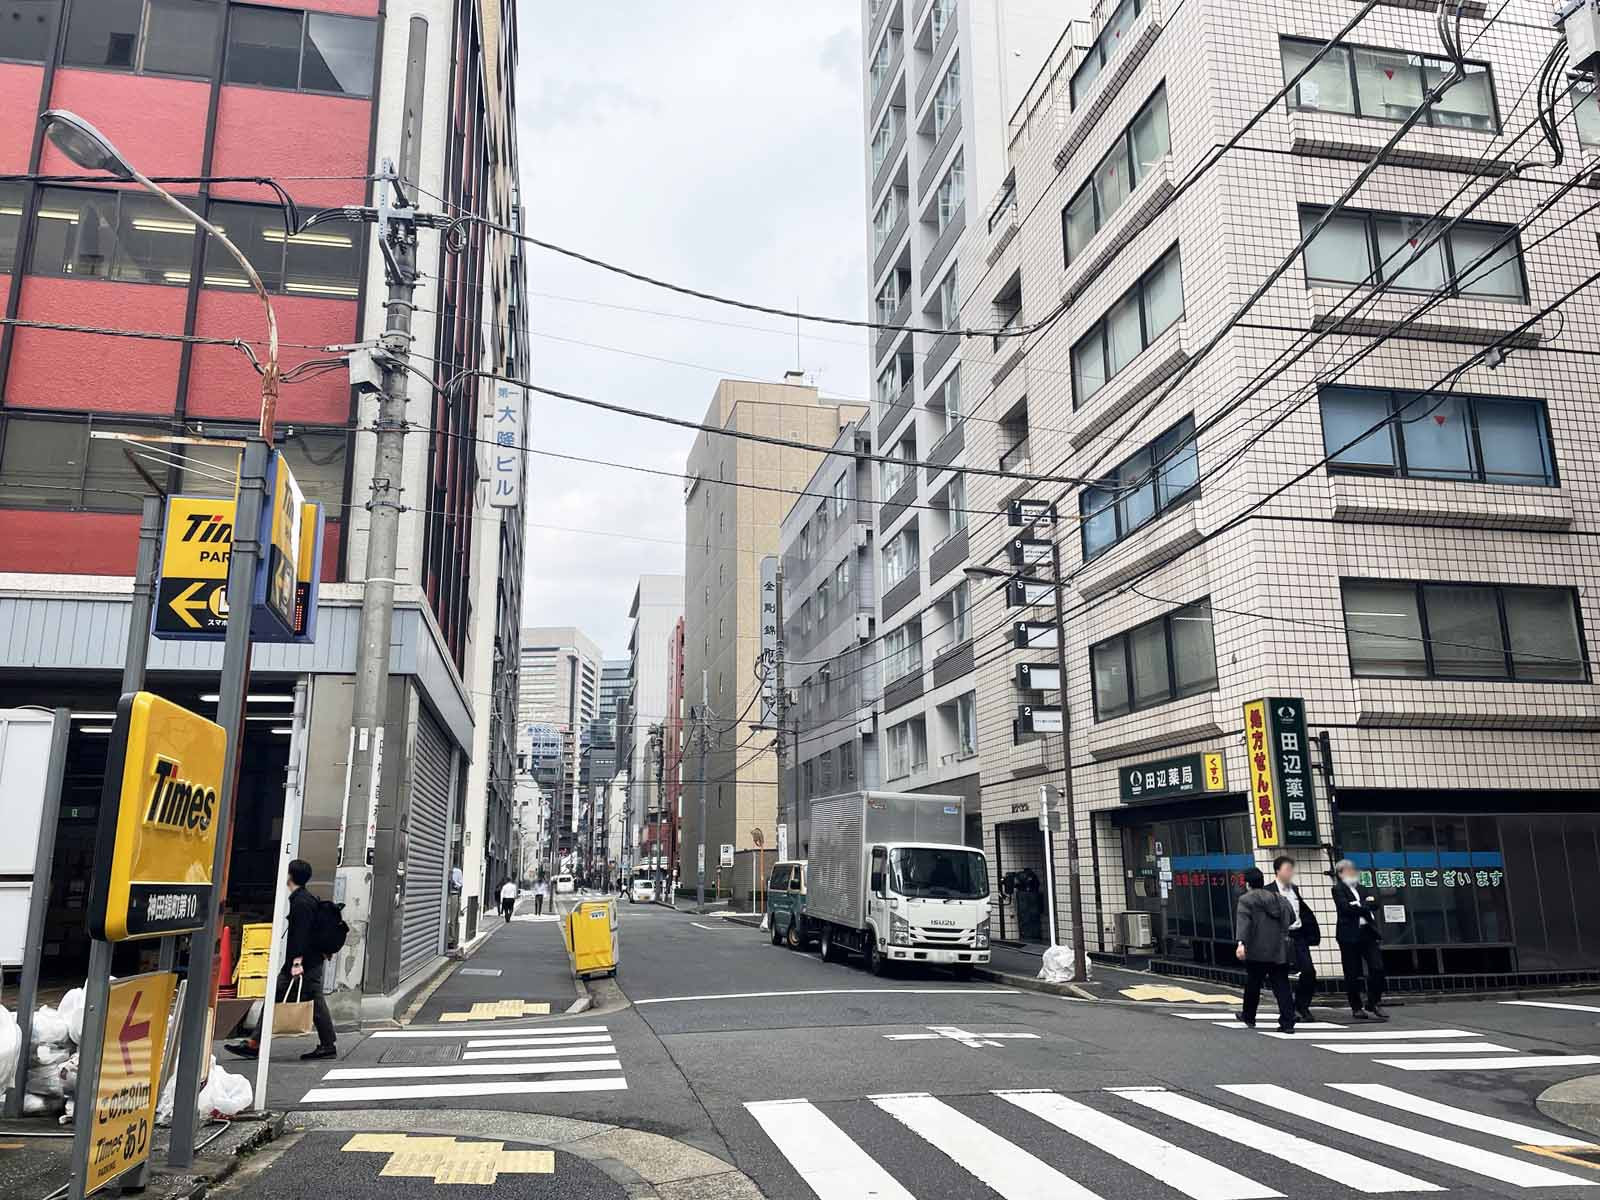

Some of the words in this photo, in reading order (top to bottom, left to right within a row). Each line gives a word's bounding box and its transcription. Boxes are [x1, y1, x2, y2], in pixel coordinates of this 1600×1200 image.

[1013, 500, 1020, 509] 7
[181, 513, 232, 543] Tim
[1015, 539, 1022, 549] 6
[199, 551, 231, 563] PAR
[1017, 580, 1024, 589] 5
[207, 619, 229, 627] スマホ
[1019, 623, 1026, 631] 4
[1022, 665, 1029, 673] 3
[1024, 707, 1031, 715] 2
[1145, 765, 1193, 790] 田辺薬局
[1209, 758, 1220, 785] くすり
[1250, 708, 1274, 840] 処方せん受付
[1280, 731, 1307, 822] 田辺薬局
[146, 757, 216, 832] Times
[147, 893, 197, 922] 神田錦町第10
[94, 1133, 124, 1165] Times
[123, 1117, 147, 1161] あり
